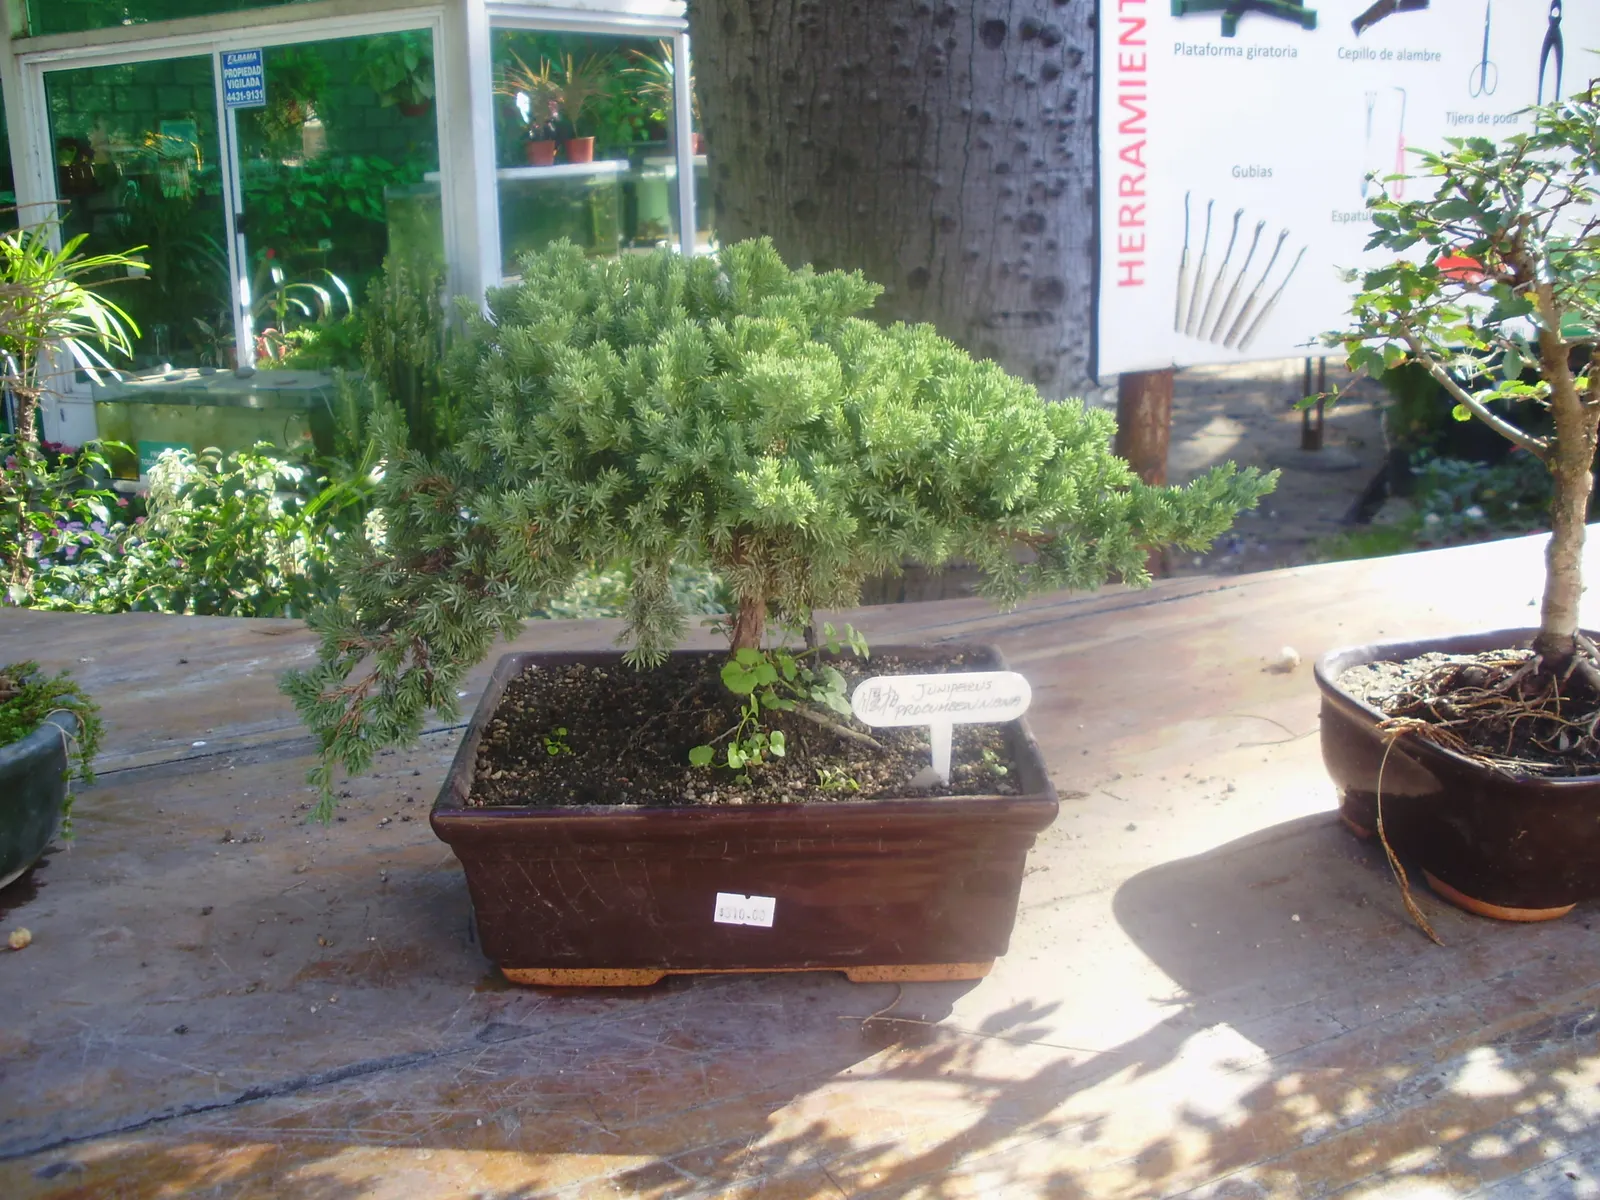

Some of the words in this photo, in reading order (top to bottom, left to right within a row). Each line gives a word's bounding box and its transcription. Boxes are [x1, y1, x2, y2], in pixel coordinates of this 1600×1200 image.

[1174, 42, 1243, 56] Plataforma
[1246, 45, 1298, 60] giratoria
[1338, 46, 1376, 62] Cepillo
[1380, 47, 1393, 60] de
[1397, 47, 1441, 61] alambre
[224, 65, 261, 79] PROPIEDAD
[226, 77, 260, 89] VIGILADA
[226, 90, 264, 102] 4431-9131
[1446, 111, 1474, 126] Tijera
[1477, 112, 1490, 124] de
[1232, 165, 1273, 178] Gubias
